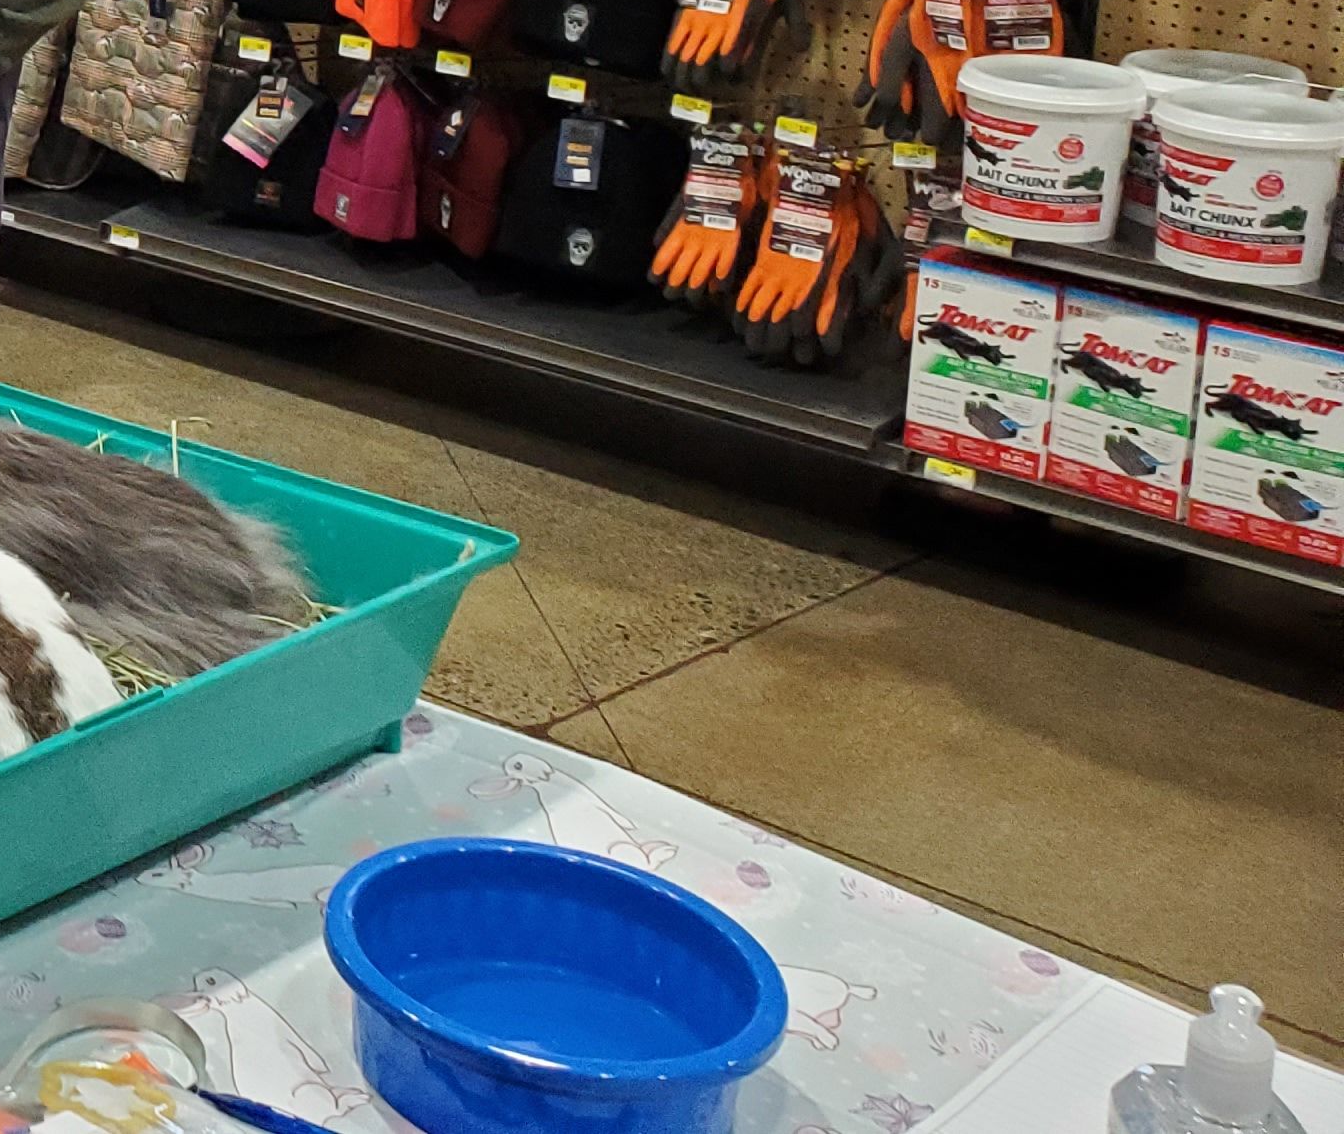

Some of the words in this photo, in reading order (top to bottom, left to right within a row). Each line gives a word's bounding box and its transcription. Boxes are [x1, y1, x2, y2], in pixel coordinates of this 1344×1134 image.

[778, 163, 841, 188] WONDER
[977, 166, 1002, 183] BAIT
[1004, 172, 1060, 190] CHUNX
[1198, 209, 1256, 228] CHUNX
[923, 277, 939, 289] 15
[938, 303, 1037, 342] TOMCAT
[1080, 332, 1178, 374] TOMCAT
[1212, 344, 1231, 358] 15
[1228, 373, 1343, 416] TOMCAT
